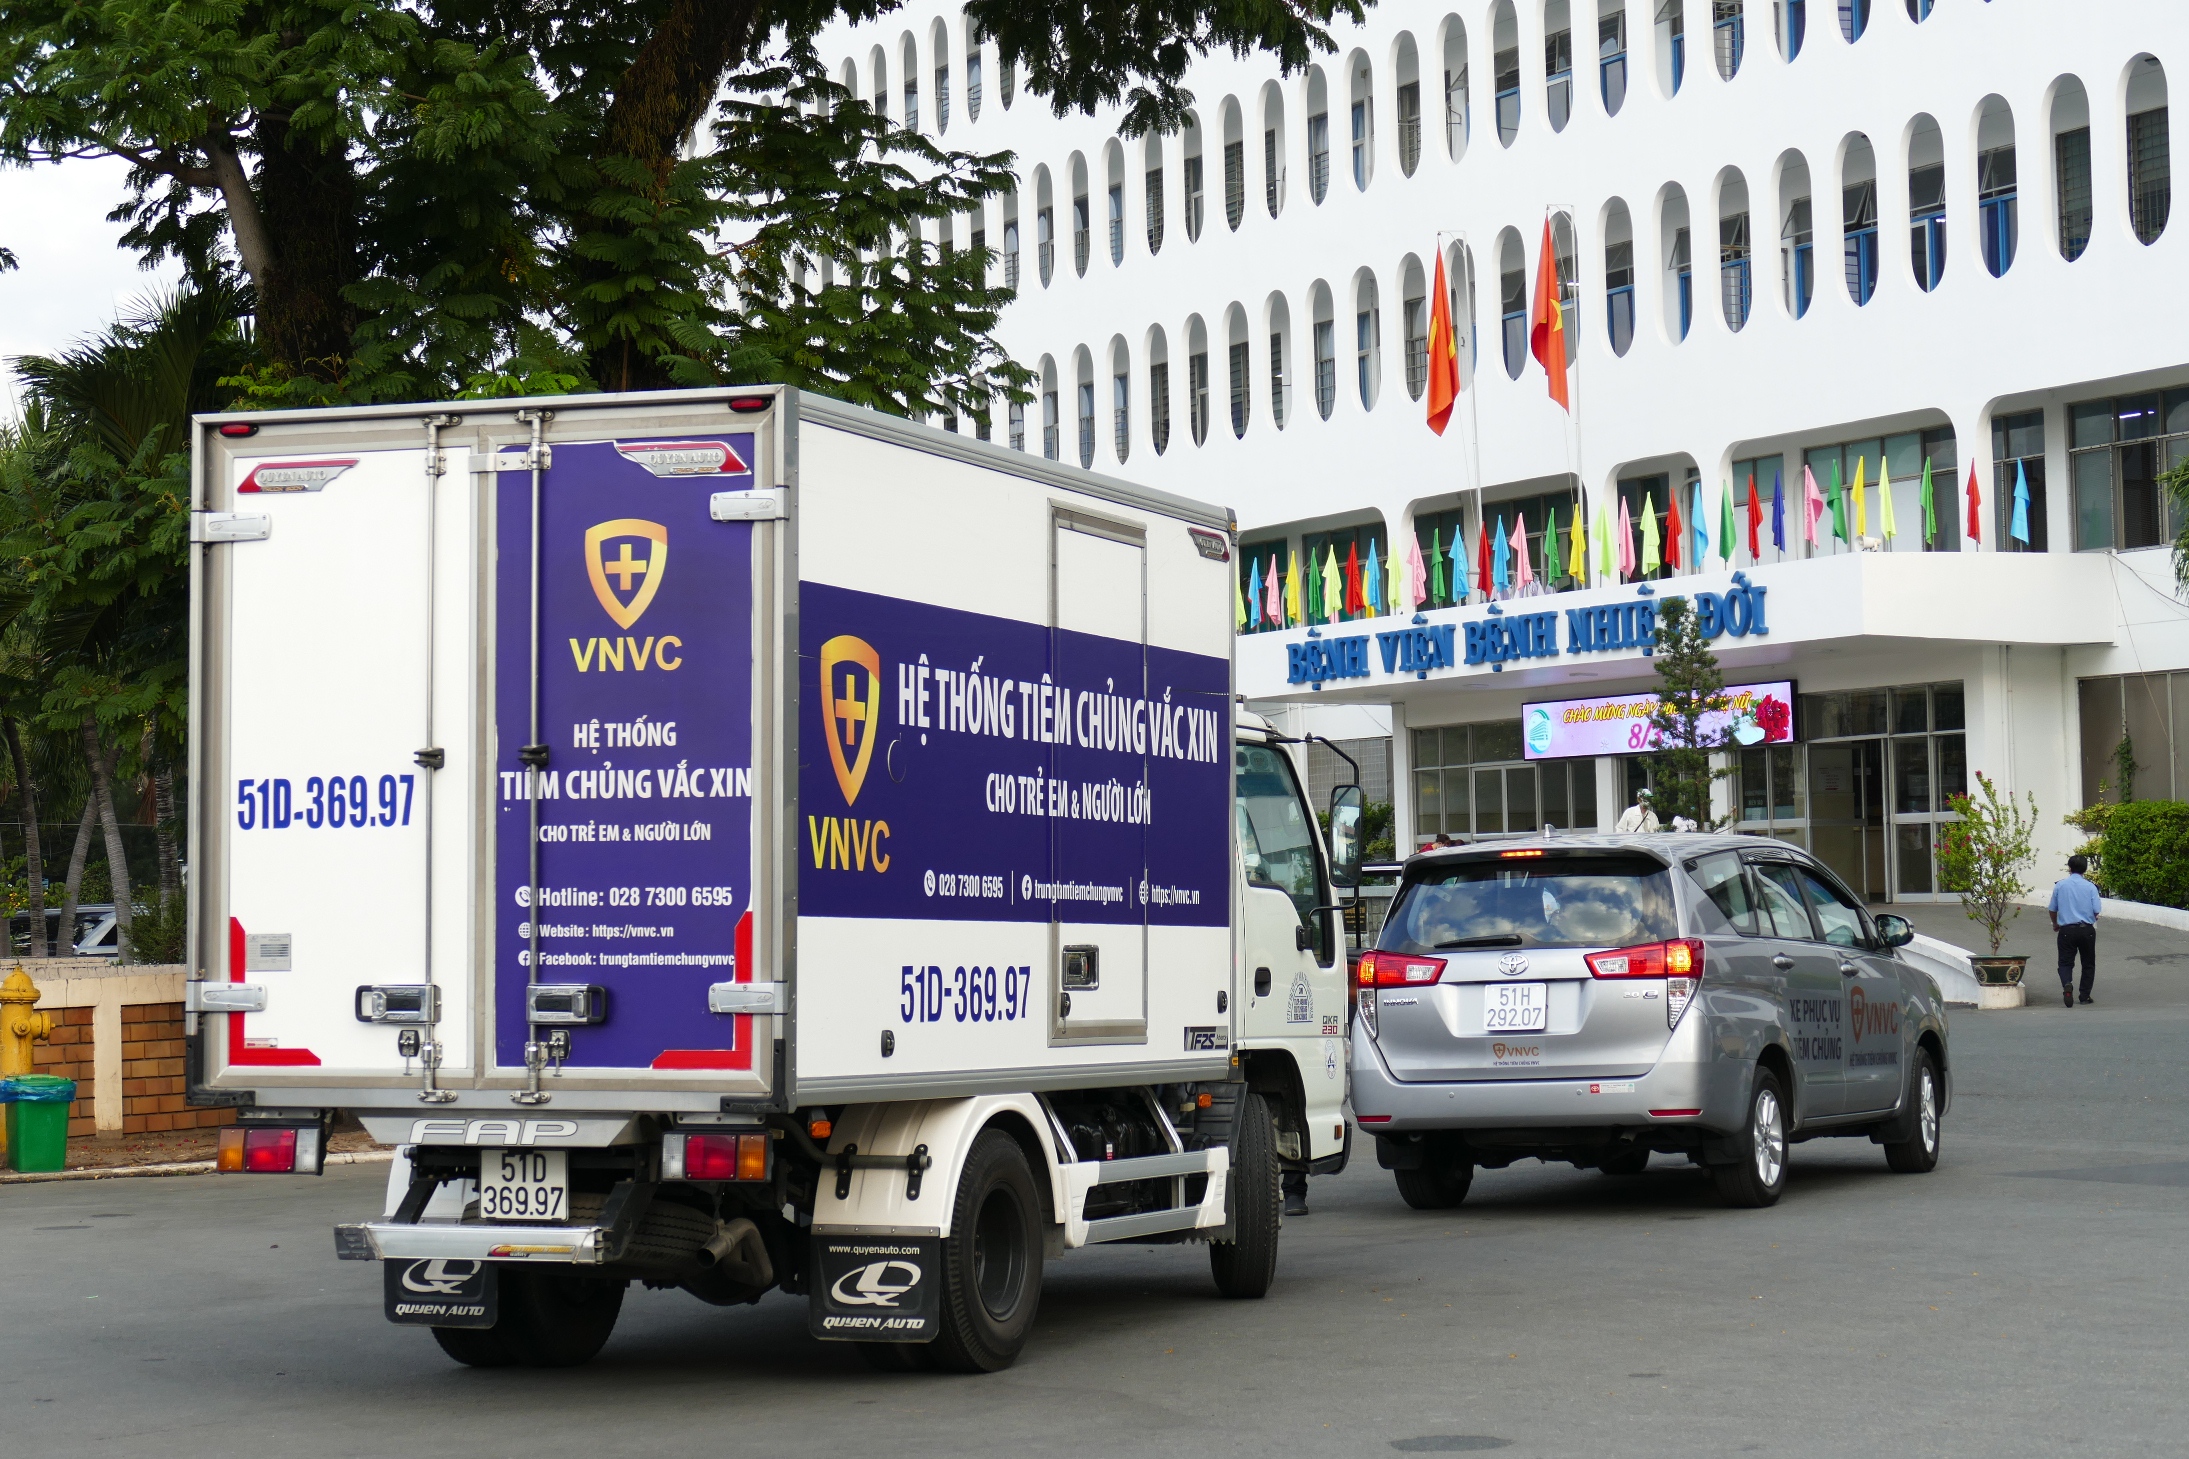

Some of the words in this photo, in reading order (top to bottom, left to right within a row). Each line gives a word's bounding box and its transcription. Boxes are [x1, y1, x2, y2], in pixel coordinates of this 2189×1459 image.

[690, 452, 721, 464] AUTO
[1286, 627, 1370, 691] BỆNH
[1375, 612, 1457, 680] VIỆN
[1462, 603, 1559, 673] BỆNH
[1565, 583, 1686, 656] NHIỆ
[569, 635, 682, 672] VNVC
[899, 653, 930, 746] HỆ
[935, 655, 1015, 739] THỐNG
[1019, 673, 1071, 745] TIÊM
[1076, 677, 1146, 754] CHỦNG
[1148, 685, 1184, 760] VẮC
[1187, 707, 1218, 763] XIN
[1563, 704, 1592, 724] CHÀO
[574, 718, 600, 754] HỆ
[604, 714, 677, 747] THỐNG
[565, 761, 651, 799] CHỦNG
[657, 759, 705, 798] VẮC
[709, 768, 751, 797] XIN
[237, 774, 414, 831] 51D-369.97
[986, 772, 1016, 813] CHO
[1018, 766, 1044, 816] TRẺ
[1048, 778, 1069, 818] EM
[1071, 789, 1080, 819] &
[1082, 777, 1124, 823] NGƯỜI
[1127, 780, 1151, 825] LỚN
[539, 825, 568, 842] CHO
[570, 820, 595, 842] TRẺ
[598, 825, 620, 842] EM
[622, 828, 631, 841] &
[634, 820, 680, 841] NGƯỜI
[683, 820, 711, 841] LỚN
[808, 815, 890, 873] VNVC
[539, 887, 604, 906] Hotline:
[609, 887, 640, 906] 028
[645, 887, 687, 906] 7300
[691, 887, 733, 906] 6595
[939, 874, 956, 896] 028
[958, 875, 980, 897] 7300
[982, 876, 1004, 898] 6595
[1035, 879, 1124, 906] trungtamtiemchungvnvc
[1152, 884, 1200, 908] https://vnvc.vn
[539, 924, 589, 938] Website:
[592, 923, 674, 940] https://vnvc.vn
[539, 952, 597, 966] Facebook:
[599, 952, 735, 968] trungtamtiemchungvnvc
[901, 965, 1031, 1023] 51D-369.97
[1499, 987, 1531, 1006] 51H
[1322, 1015, 1339, 1025] QKR
[1487, 1007, 1542, 1027] 292.07
[1790, 999, 1801, 1022] XE
[1804, 999, 1827, 1029] PHỤC
[1829, 999, 1840, 1029] VỤ
[1866, 1002, 1898, 1035] VNVC
[1322, 1025, 1338, 1034] 230
[1506, 1046, 1540, 1057] VNVC
[1812, 1028, 1842, 1060] CHỦNG
[409, 1118, 578, 1145] FAP
[502, 1153, 547, 1183] 51D
[483, 1186, 564, 1216] 369.97
[829, 1245, 920, 1256] www.quyenauto.com
[445, 1305, 485, 1317] AUTO
[880, 1318, 925, 1331] AUTO
